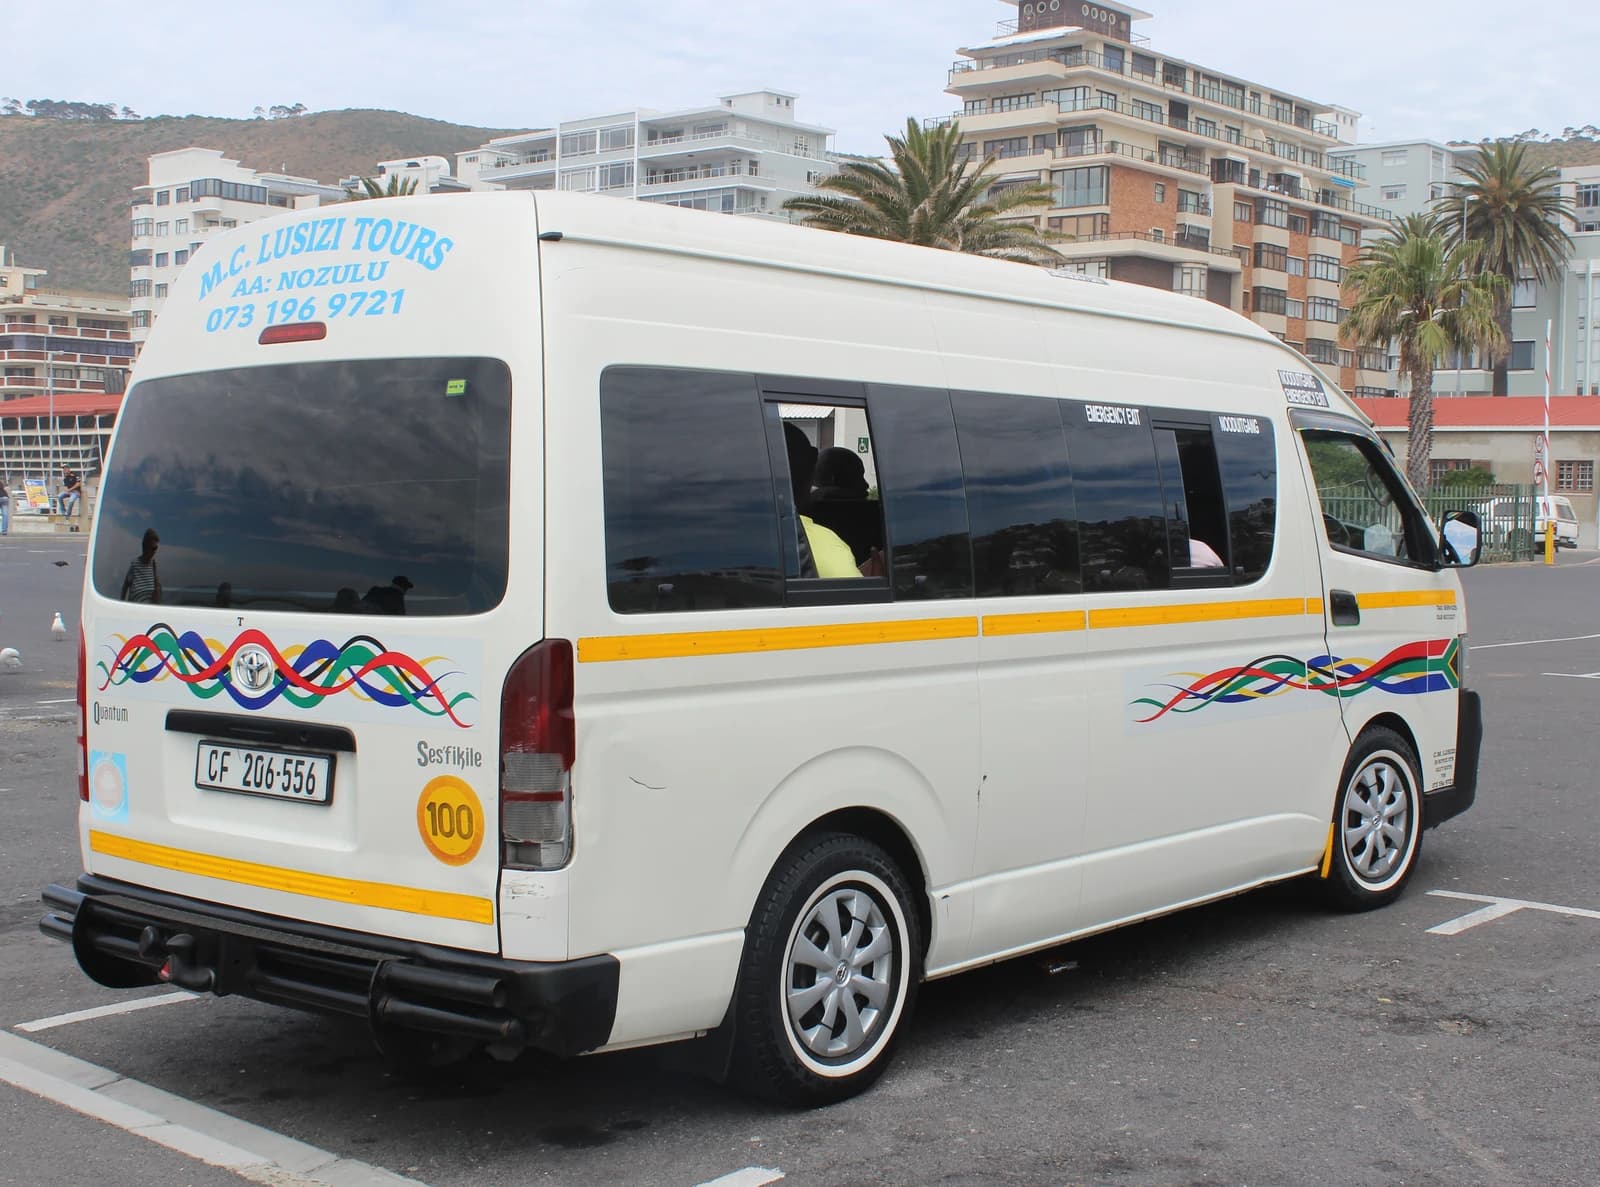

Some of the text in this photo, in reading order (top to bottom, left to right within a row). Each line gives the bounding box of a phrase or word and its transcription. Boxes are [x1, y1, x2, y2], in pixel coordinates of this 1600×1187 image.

[199, 217, 454, 301] M.C. LUSIZI TOURS
[231, 260, 389, 297] AA: NOZULU
[205, 288, 406, 333] 073 196 9721
[1284, 388, 1329, 407] EMERGENCY EXIT
[1085, 404, 1141, 426] EMERGENCY EXIT
[237, 616, 244, 627] T
[94, 701, 129, 725] Quantum
[208, 749, 231, 783] CF
[426, 801, 474, 840] 100
